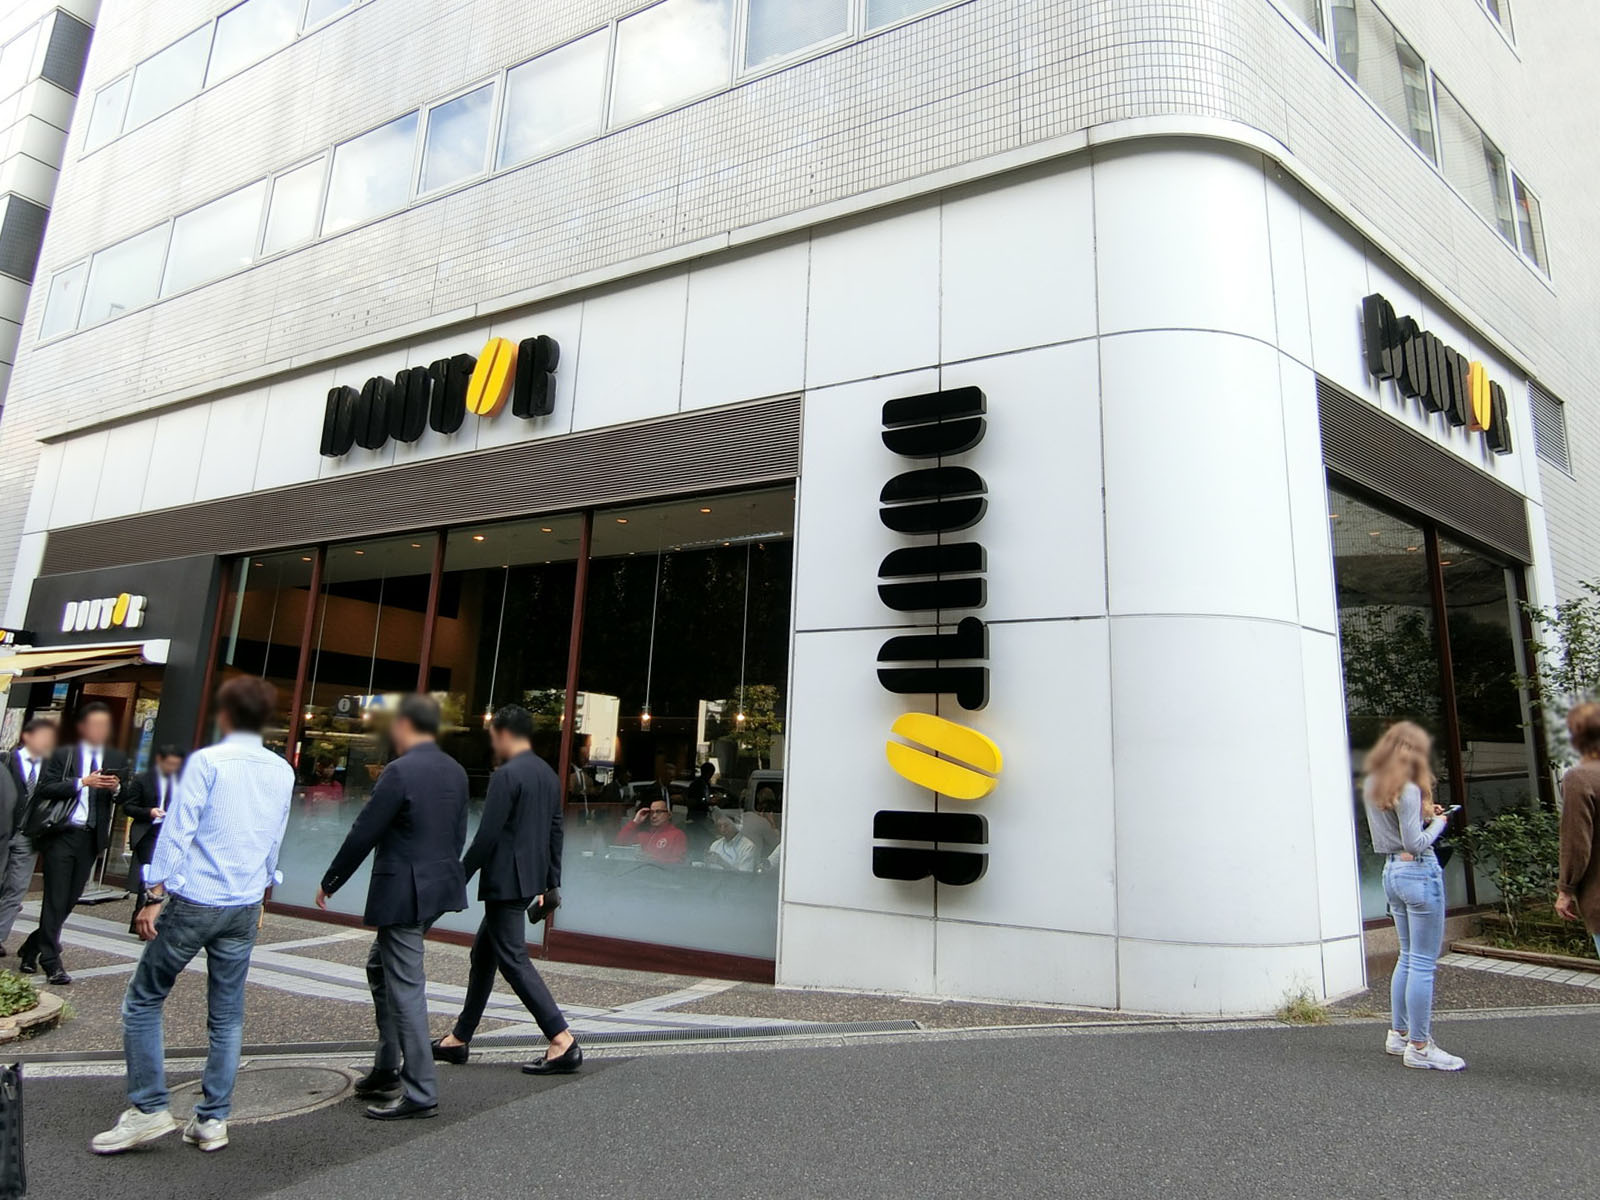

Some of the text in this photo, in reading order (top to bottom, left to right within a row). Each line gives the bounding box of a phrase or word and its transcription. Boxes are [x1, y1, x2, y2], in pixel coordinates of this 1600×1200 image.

[320, 335, 560, 457] DOUTOR
[61, 592, 147, 632] DOUTOR
[872, 385, 1003, 885] DOUTOR
